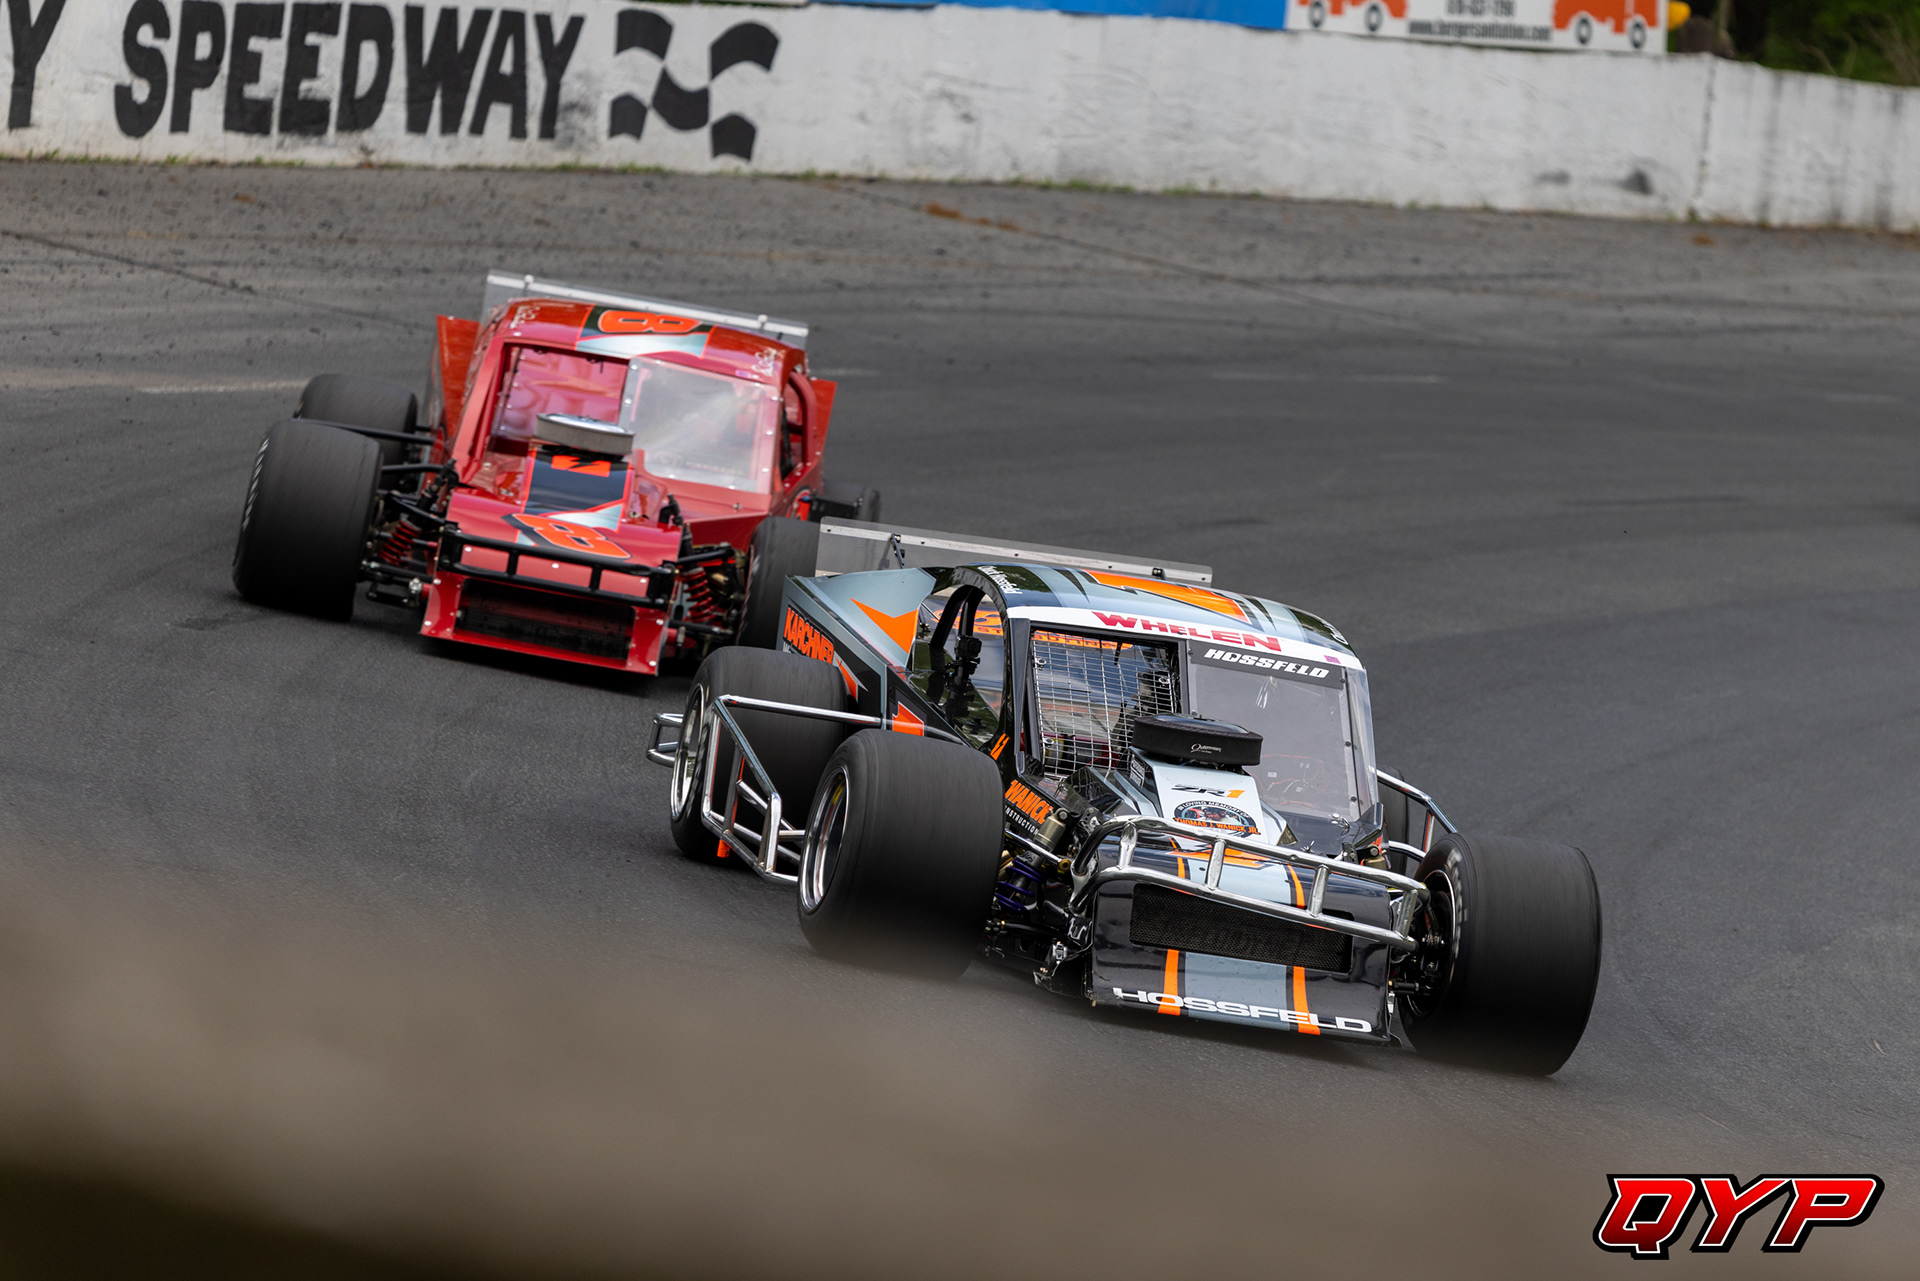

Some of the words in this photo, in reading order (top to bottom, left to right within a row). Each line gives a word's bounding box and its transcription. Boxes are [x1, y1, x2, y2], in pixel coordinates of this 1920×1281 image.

[114, 0, 585, 139] SPEEDWAY
[598, 309, 703, 333] 8
[511, 513, 632, 559] 8
[783, 607, 834, 665] KARCHNER
[1092, 611, 1281, 652] WHELEN
[1204, 649, 1330, 679] HOSSFELD
[1005, 779, 1054, 824] WANICK
[1171, 784, 1245, 798] ZR1
[1175, 817, 1208, 828] THOMAS
[1216, 823, 1247, 833] WANICK
[1112, 987, 1372, 1033] HOSSFELD
